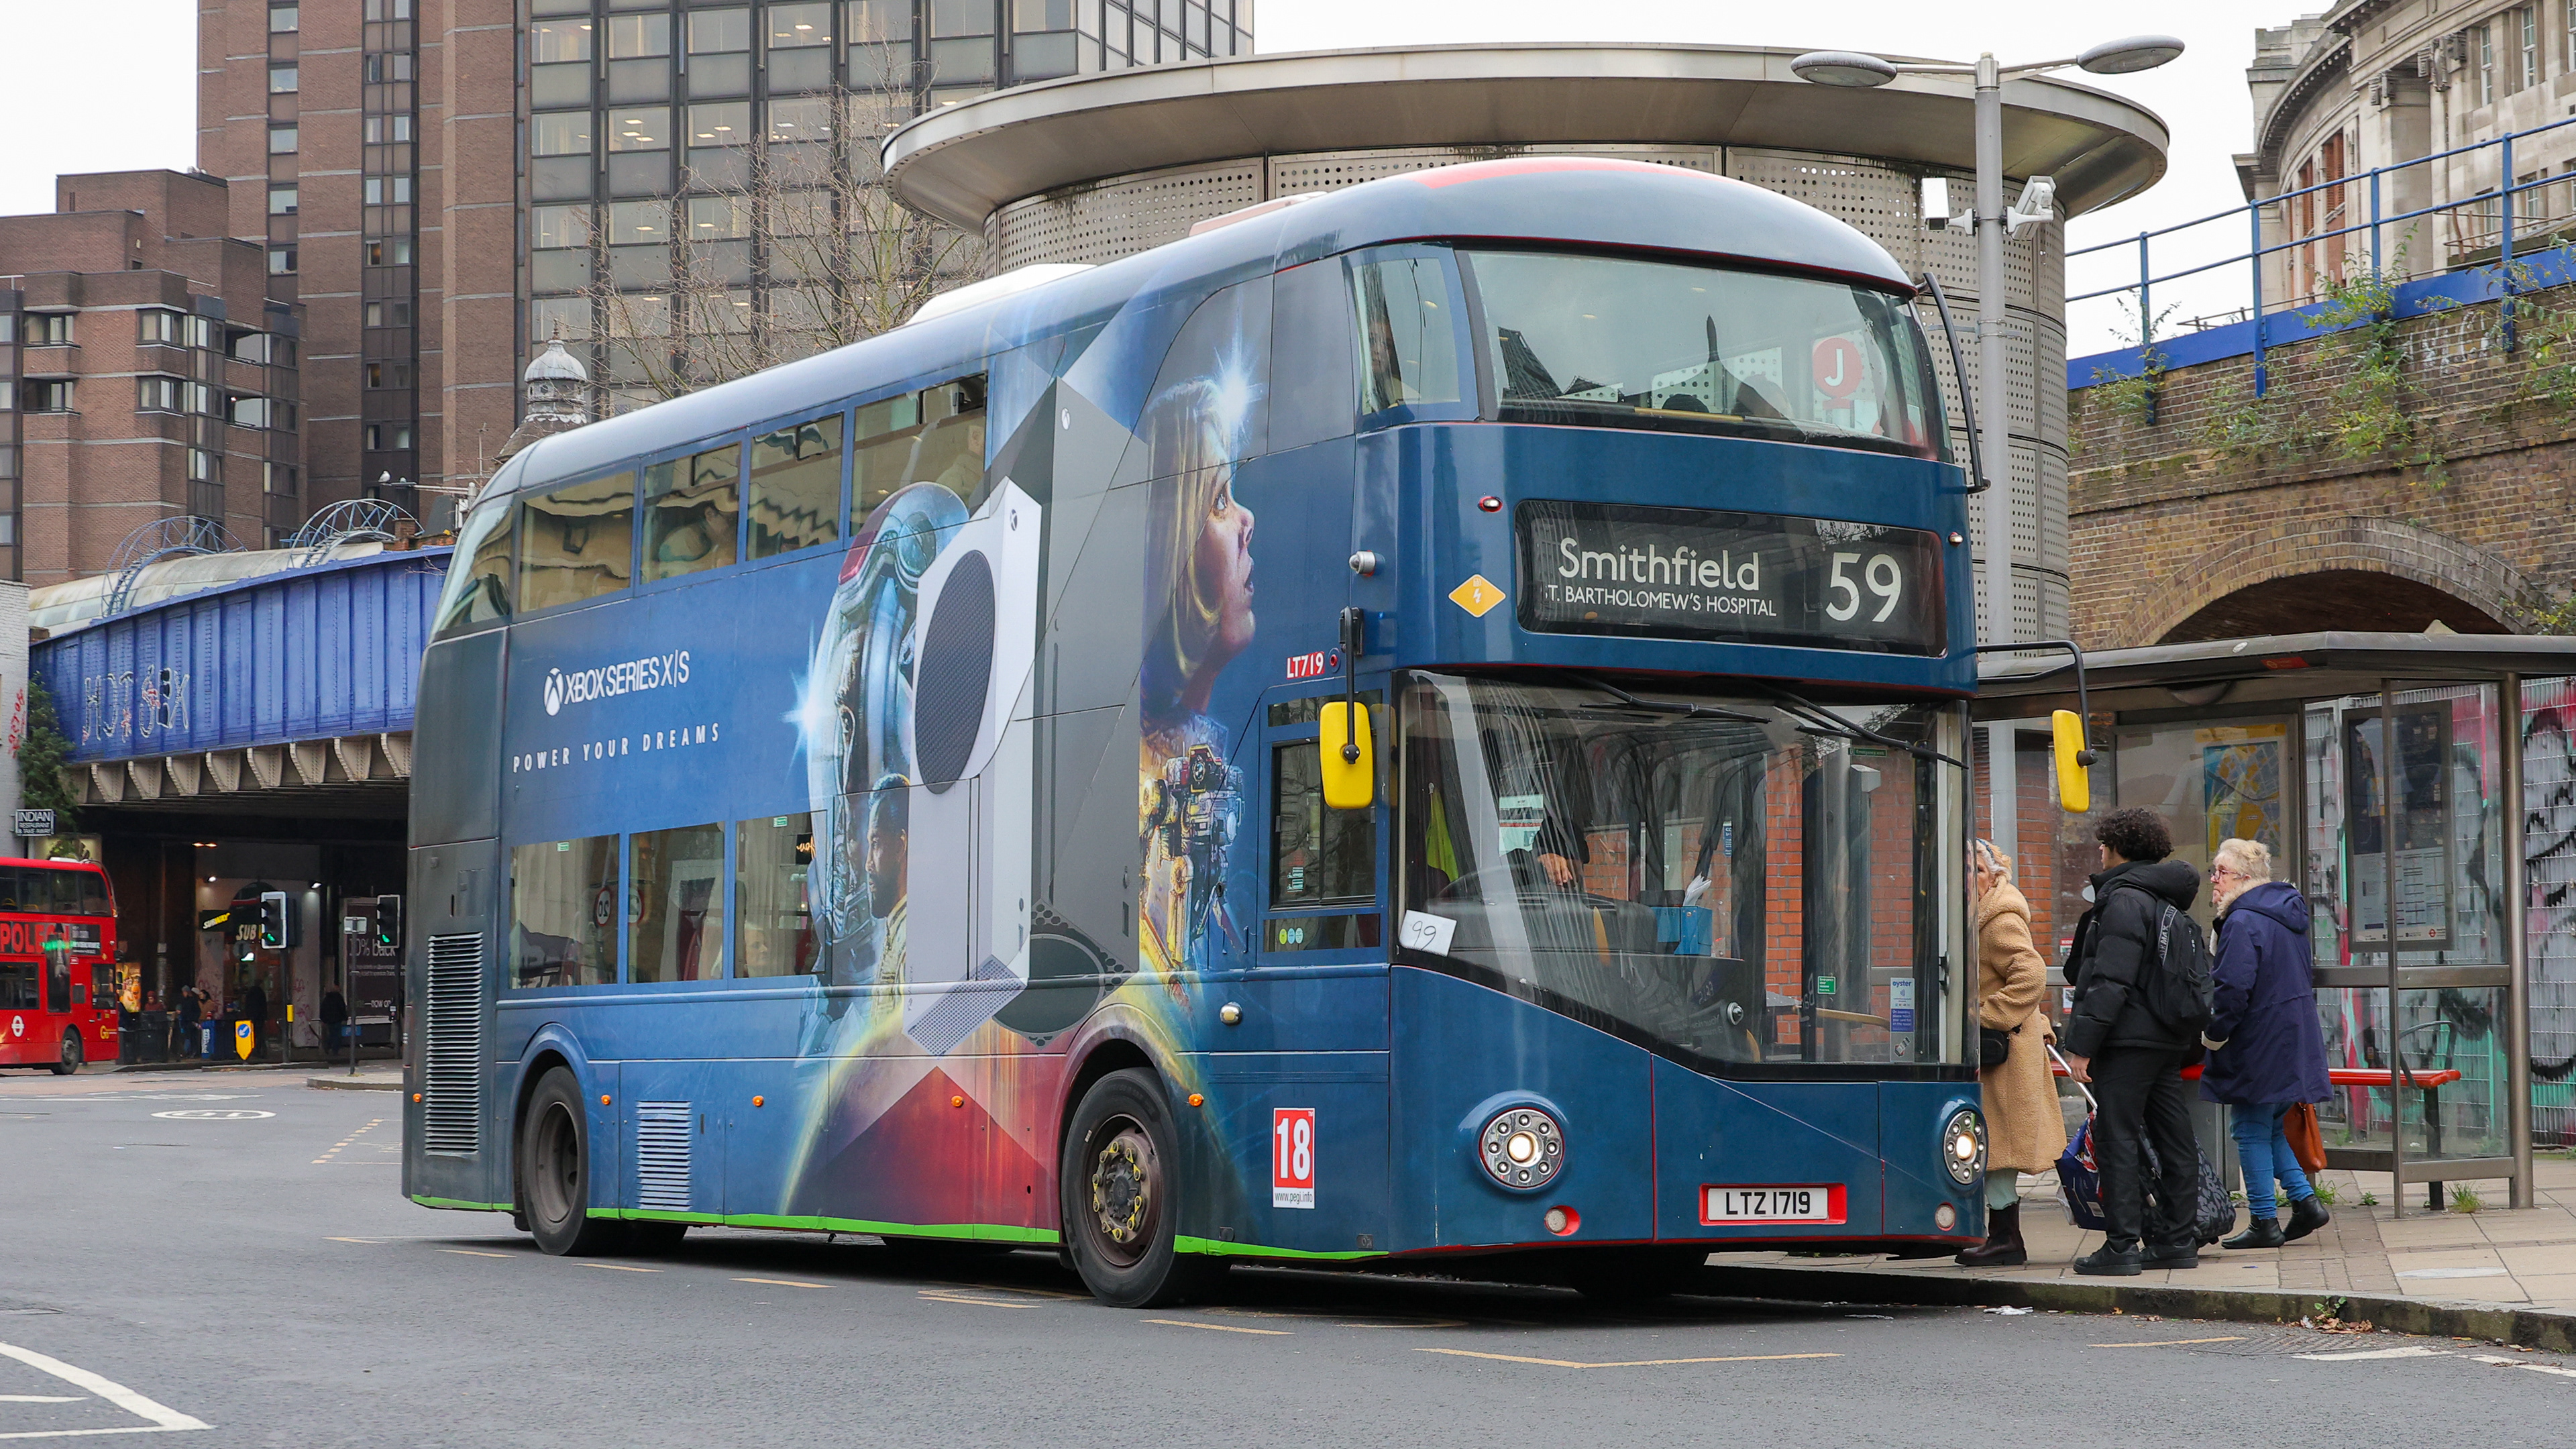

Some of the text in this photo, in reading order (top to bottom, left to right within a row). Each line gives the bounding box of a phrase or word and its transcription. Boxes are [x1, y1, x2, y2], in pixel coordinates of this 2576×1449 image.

[1824, 348, 1844, 386] J
[1558, 537, 1759, 591] Smithfield
[1545, 584, 1777, 617] T. BARTHOLOMEW'S HOSPITAL
[1825, 552, 1902, 623] 59
[564, 667, 606, 705] XBOX
[605, 656, 660, 697] SERIES
[1287, 652, 1324, 679] LT719
[513, 722, 719, 773] POWER YOUR DREAMS
[18, 811, 51, 822] INDIAN
[203, 912, 231, 929] SUBWAY
[1892, 980, 1912, 988] oyster
[1277, 1118, 1311, 1181] 18
[1275, 1191, 1313, 1204] www.pegi.info
[1726, 1191, 1811, 1215] LTZ 1719
